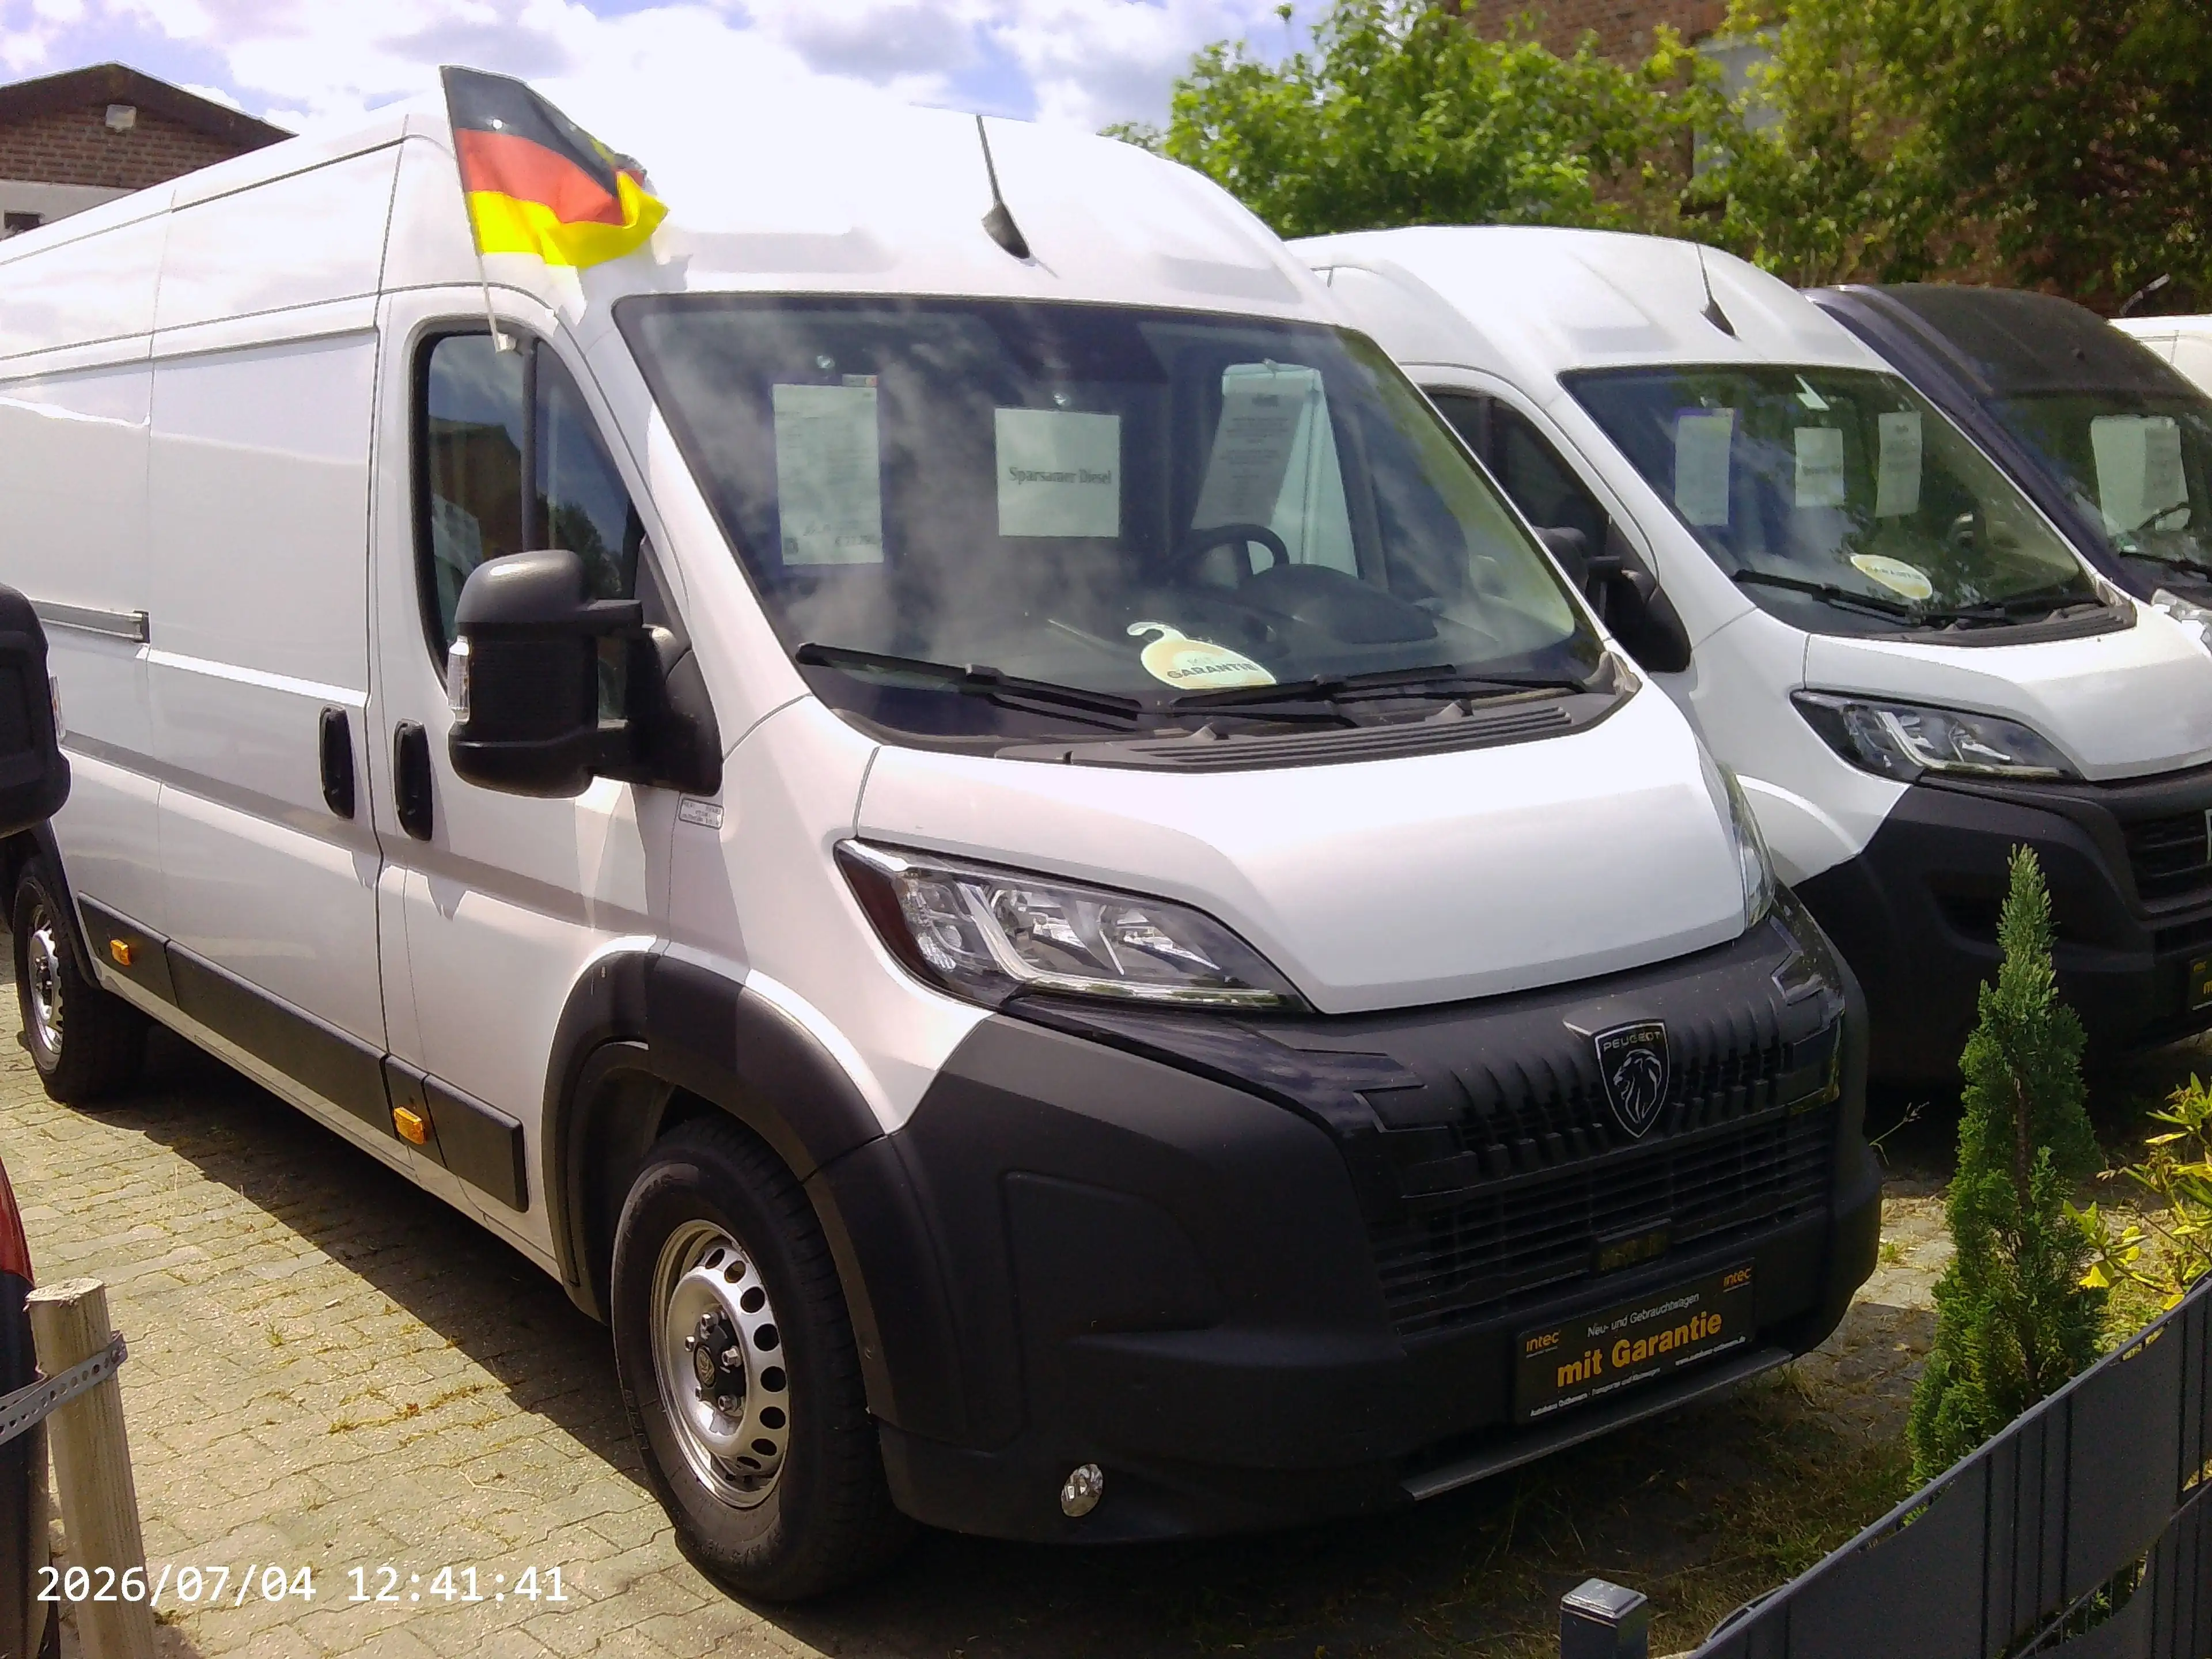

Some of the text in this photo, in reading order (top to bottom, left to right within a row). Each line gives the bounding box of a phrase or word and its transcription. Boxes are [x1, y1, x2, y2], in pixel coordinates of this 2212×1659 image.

[1079, 468, 1112, 484] Diesel
[1603, 1031, 1662, 1052] PEUGEOT
[1587, 1293, 1699, 1338] Neu- und Gebrauchtwagen
[1557, 1310, 1722, 1388] mit Garantie
